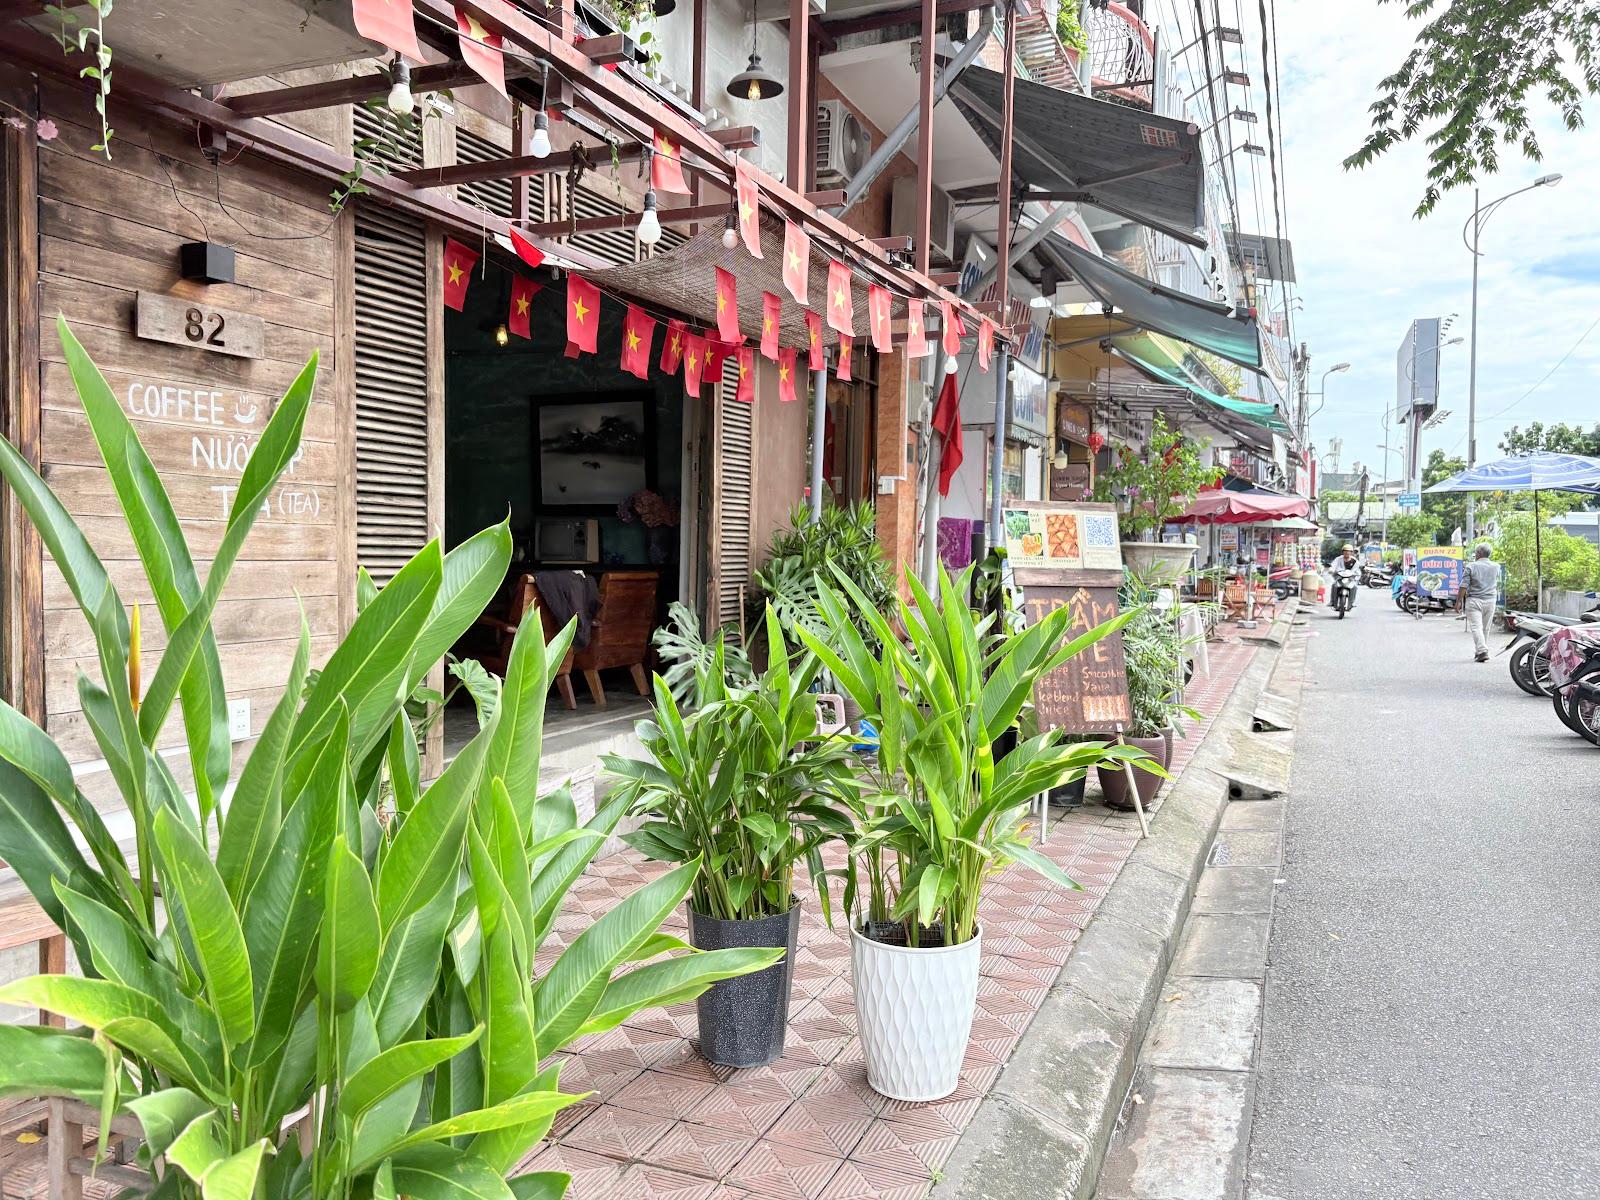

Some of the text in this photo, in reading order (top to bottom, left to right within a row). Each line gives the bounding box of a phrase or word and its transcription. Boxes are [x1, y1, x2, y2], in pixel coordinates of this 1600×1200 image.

[184, 307, 226, 347] 82
[127, 382, 225, 425] COFFEE
[191, 434, 260, 473] NƯỚ
[278, 488, 320, 517] (TEA)
